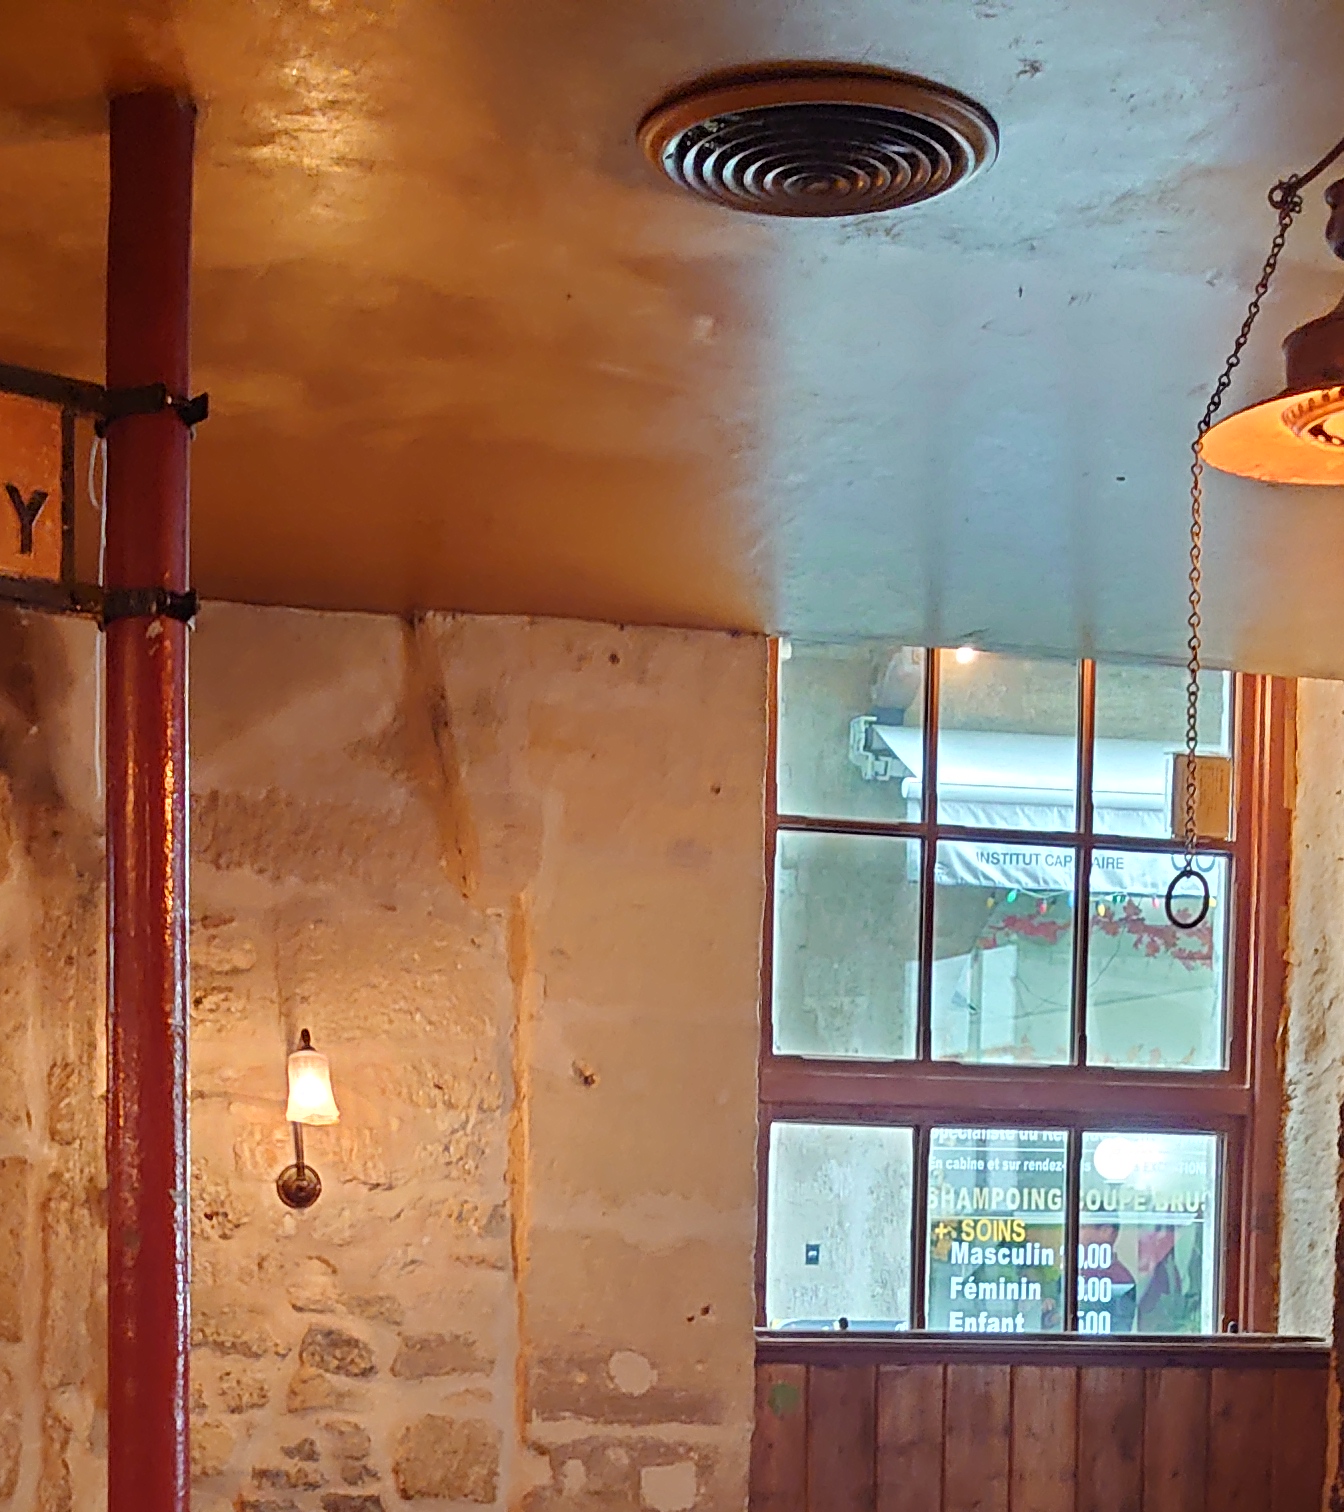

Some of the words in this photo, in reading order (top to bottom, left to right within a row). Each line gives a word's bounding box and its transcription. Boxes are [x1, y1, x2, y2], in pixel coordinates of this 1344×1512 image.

[976, 851, 1041, 867] INSTITUT
[1044, 853, 1125, 870] CAPAIRE
[945, 1156, 985, 1170] cabine
[987, 1157, 1000, 1170] et
[1002, 1160, 1022, 1171] sur
[927, 1186, 1063, 1211] SHAMPOING
[1080, 1187, 1147, 1211] OUPE
[960, 1218, 1027, 1242] SOINS
[950, 1241, 1055, 1266] Masculin
[949, 1274, 1042, 1300] Féminin
[948, 1310, 1026, 1333] Enfant
